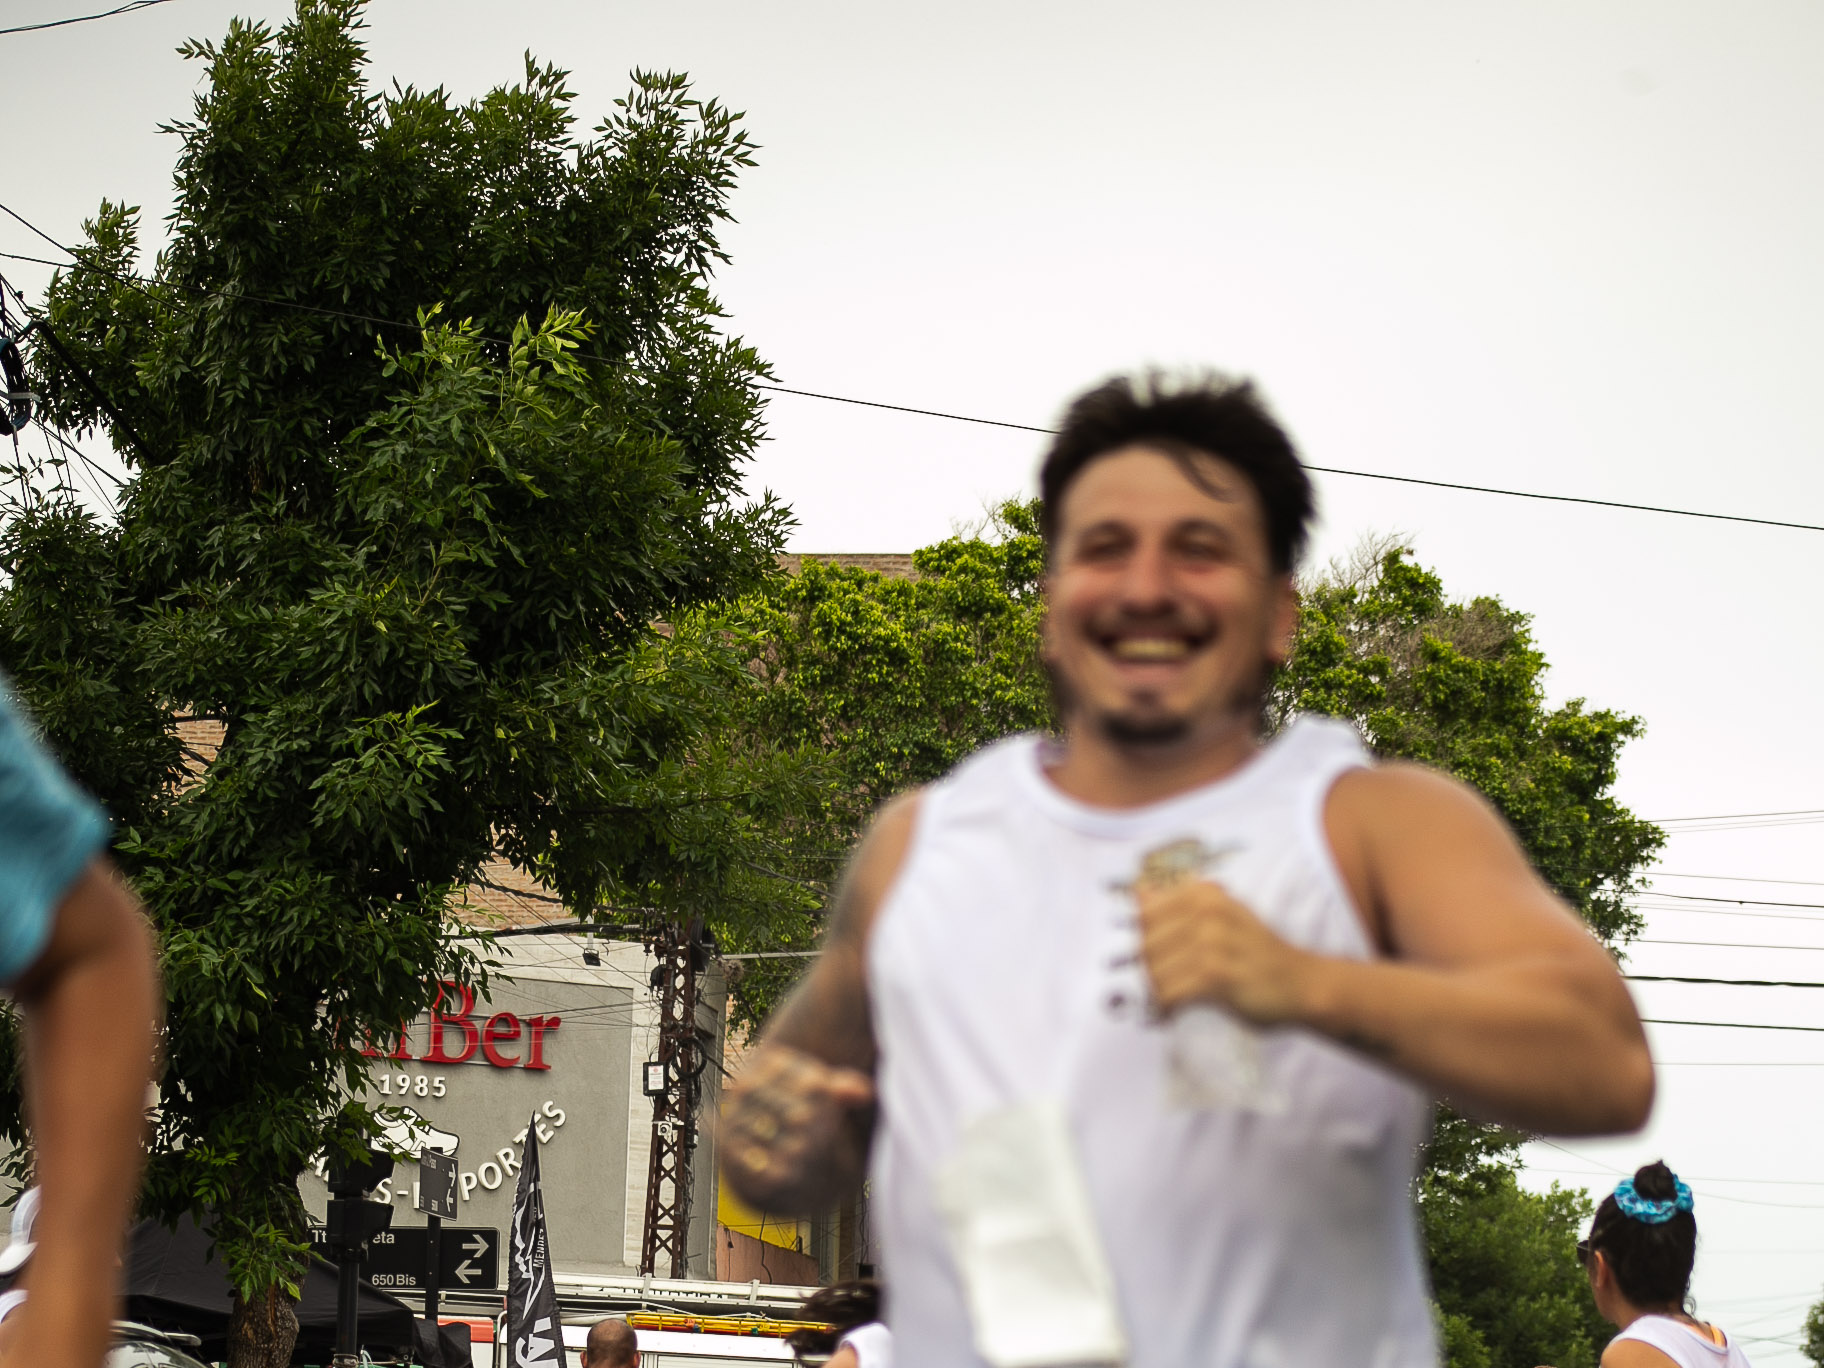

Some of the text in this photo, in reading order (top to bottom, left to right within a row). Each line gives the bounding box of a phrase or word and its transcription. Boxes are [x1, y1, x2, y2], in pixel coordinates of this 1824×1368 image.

[379, 1074, 447, 1098] 1985
[371, 1274, 417, 1286] 650 Bis
